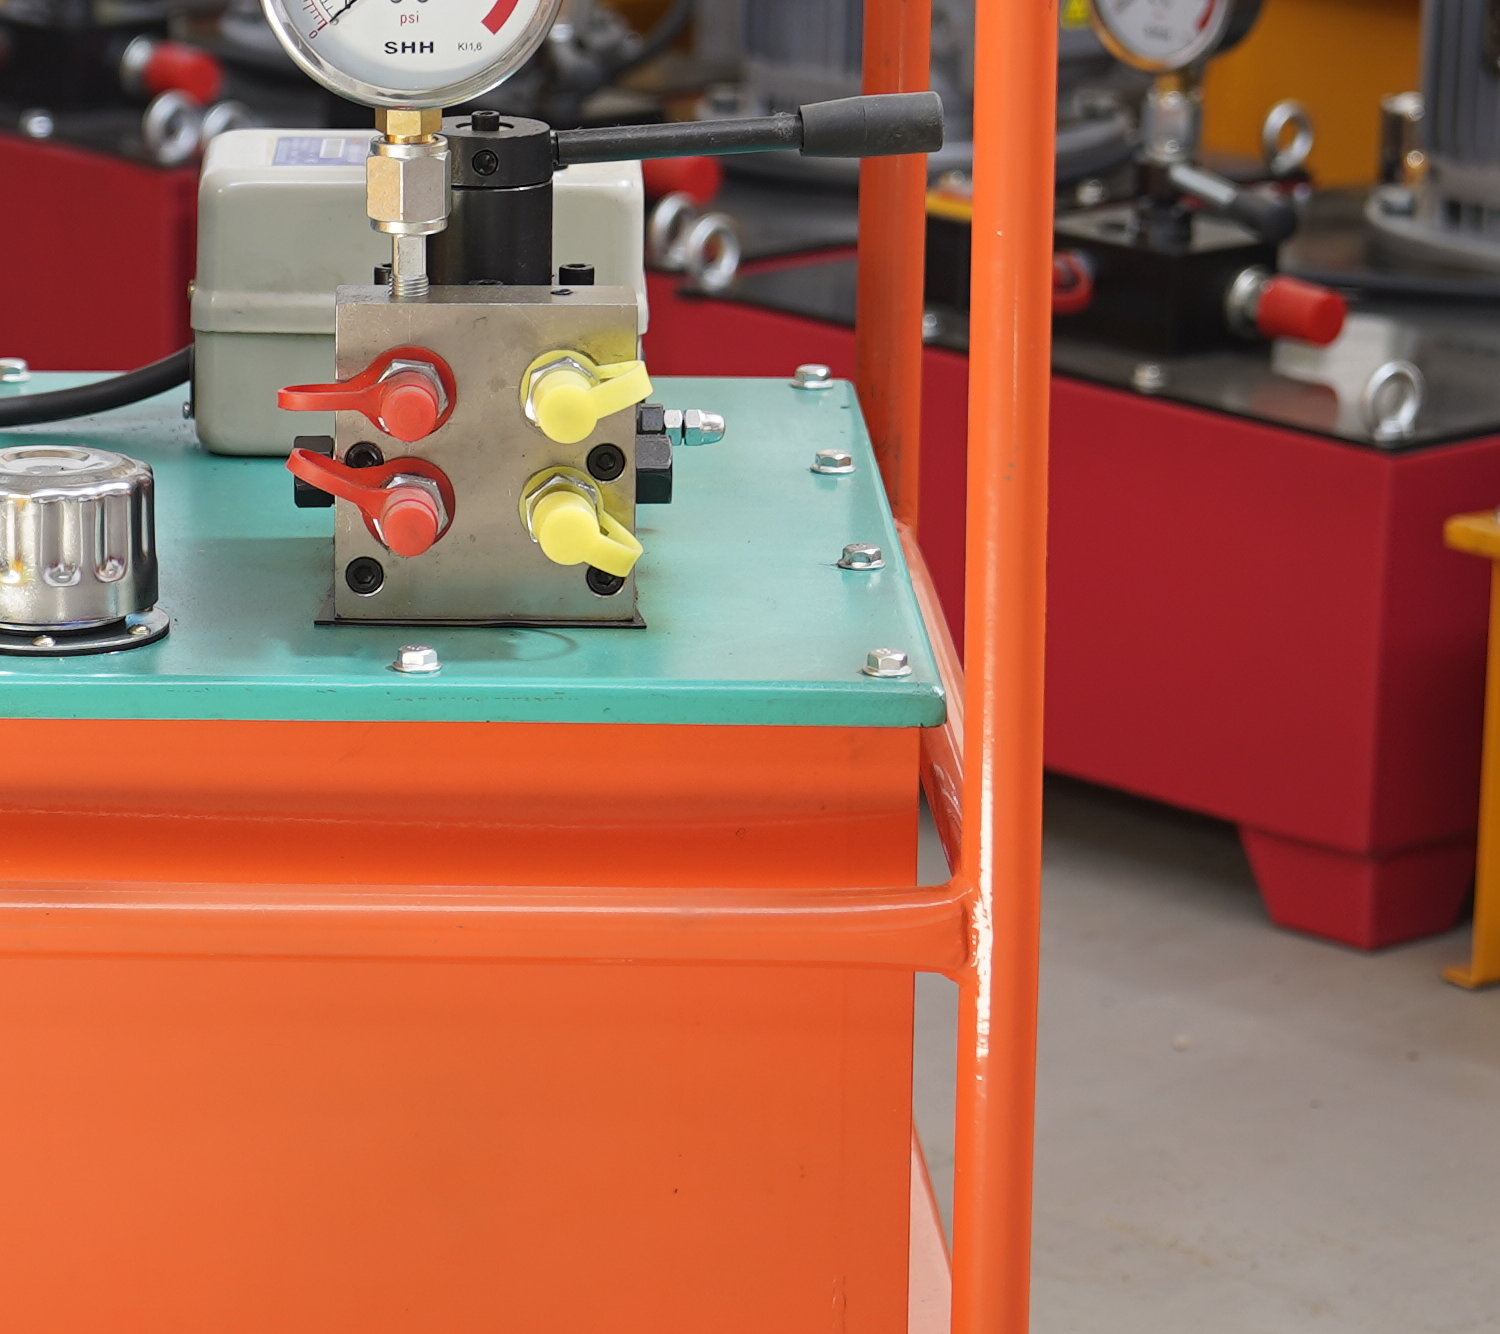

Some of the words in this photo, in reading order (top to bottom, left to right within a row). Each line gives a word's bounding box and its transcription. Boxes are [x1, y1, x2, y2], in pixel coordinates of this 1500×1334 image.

[400, 10, 420, 26] psi
[308, 30, 319, 40] 0
[384, 41, 434, 55] SHH
